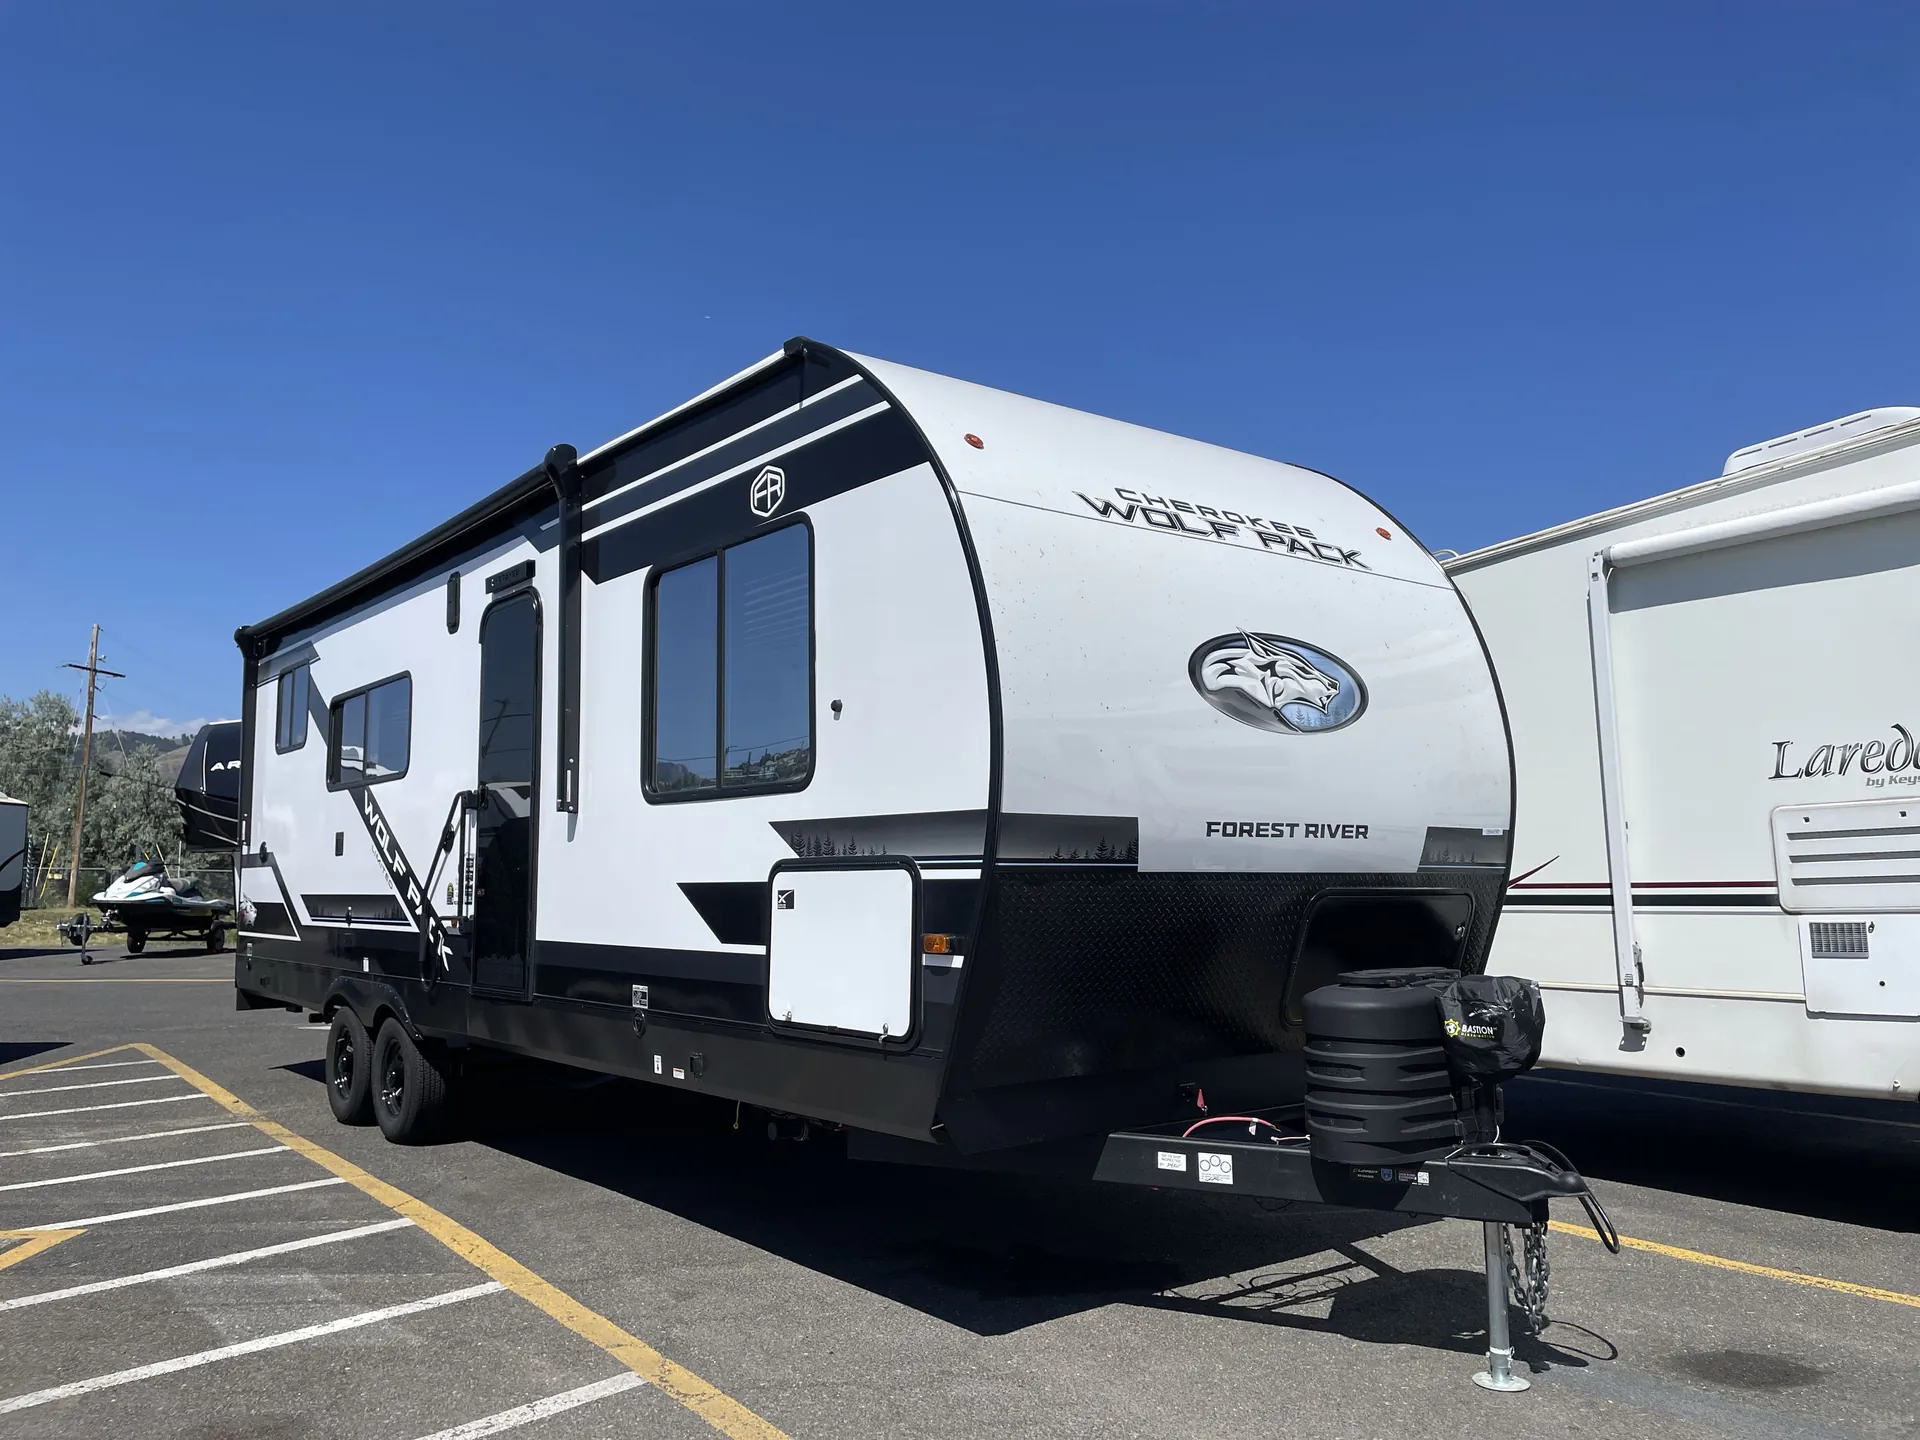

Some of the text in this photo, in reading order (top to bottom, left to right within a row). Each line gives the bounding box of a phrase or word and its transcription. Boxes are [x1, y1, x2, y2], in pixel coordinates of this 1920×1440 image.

[1072, 490, 1372, 571] WOLF PACK
[1113, 487, 1318, 539] CHEROKEE
[1866, 777, 1885, 788] by
[364, 789, 407, 876] WOLF
[1206, 821, 1369, 839] FOREST RIVER
[371, 844, 394, 890] LIMITED
[1461, 1024, 1494, 1035] BASTION
